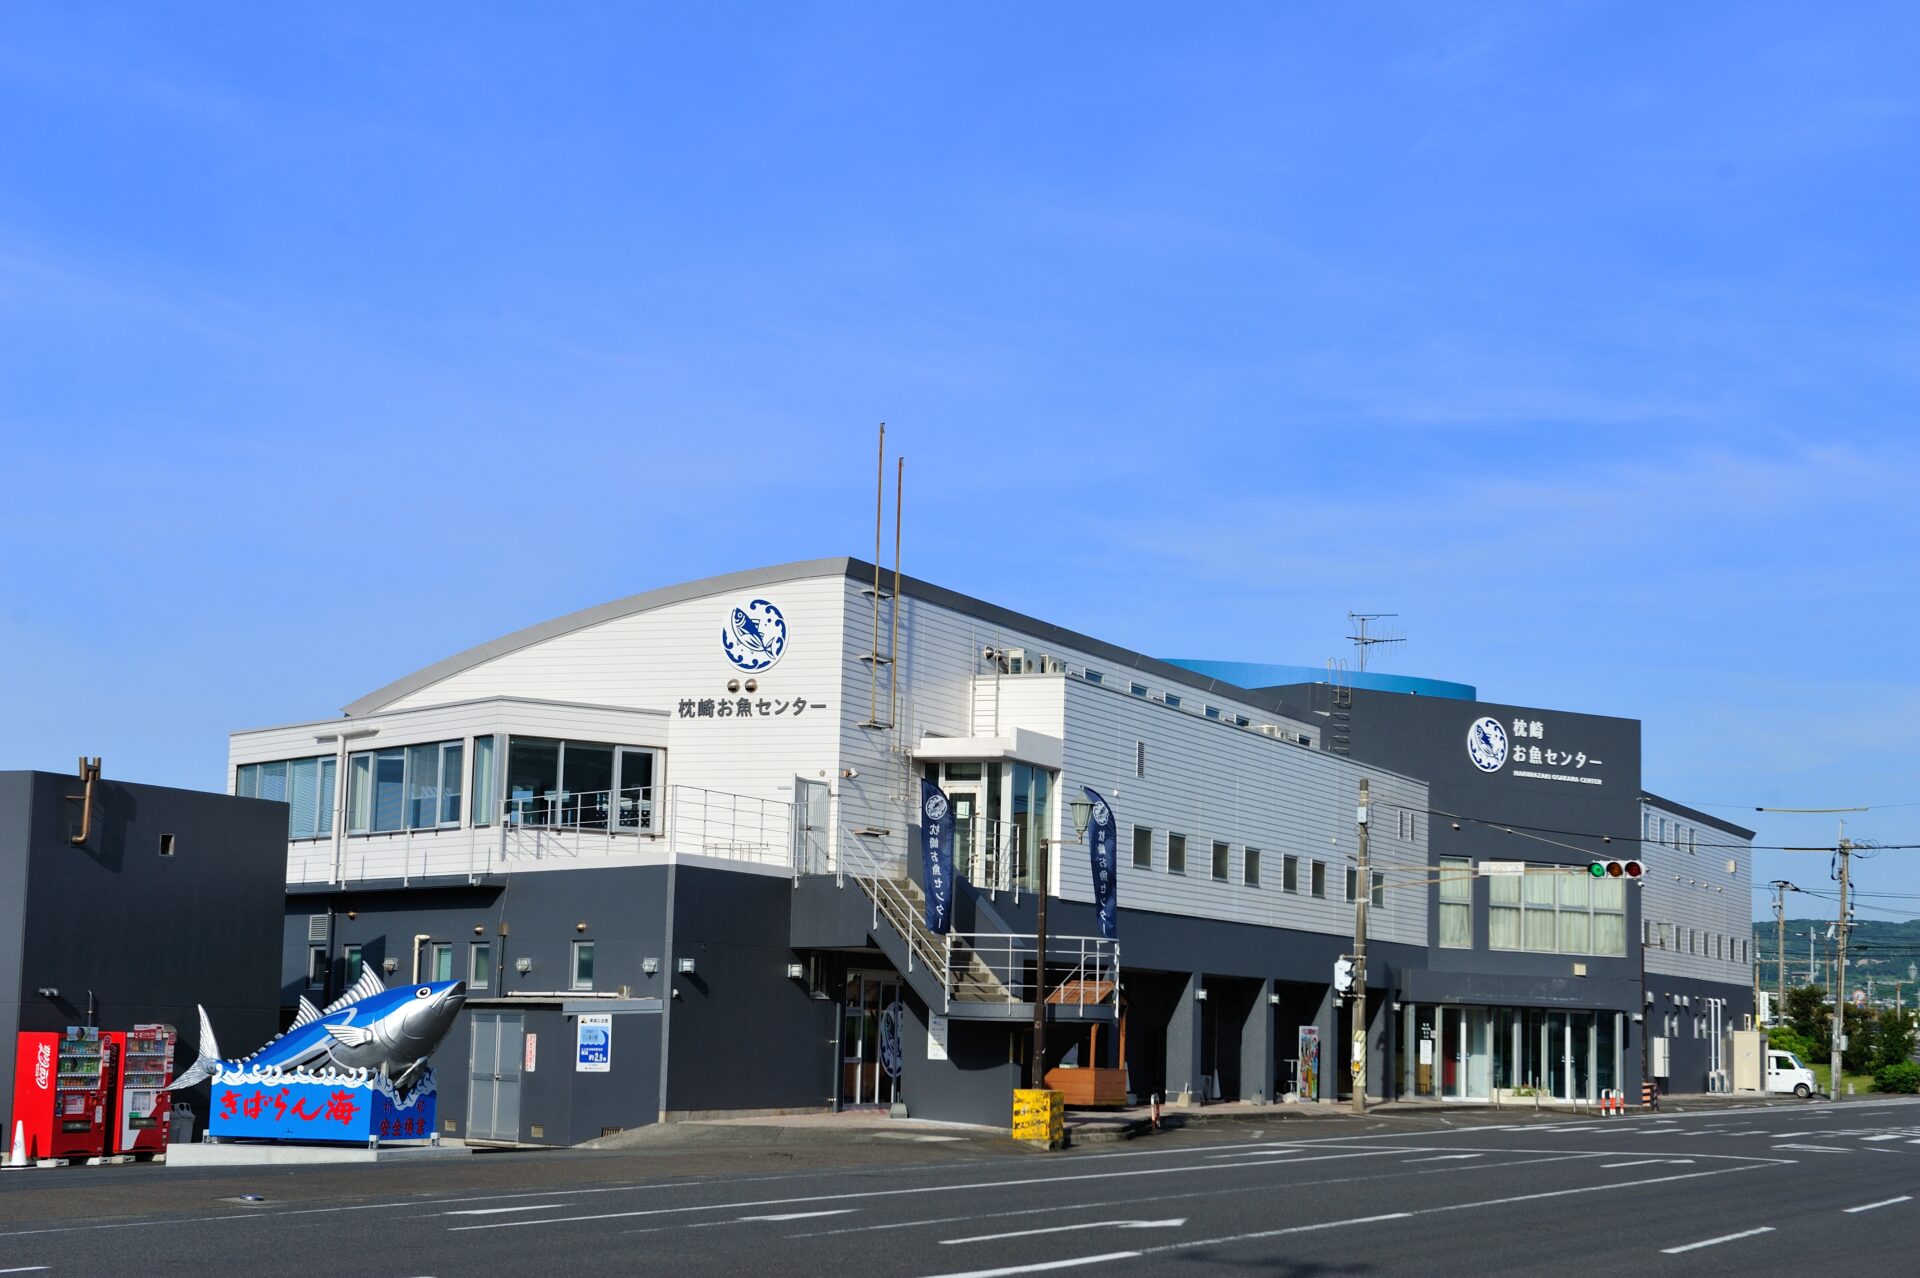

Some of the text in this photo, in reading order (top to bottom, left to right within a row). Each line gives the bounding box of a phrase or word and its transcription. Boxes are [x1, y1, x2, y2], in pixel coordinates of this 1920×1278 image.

[1512, 744, 1603, 769] お魚センター
[1579, 777, 1603, 786] CENTER
[36, 1042, 51, 1090] Coca-Cola
[219, 1087, 361, 1127] きばらん海
